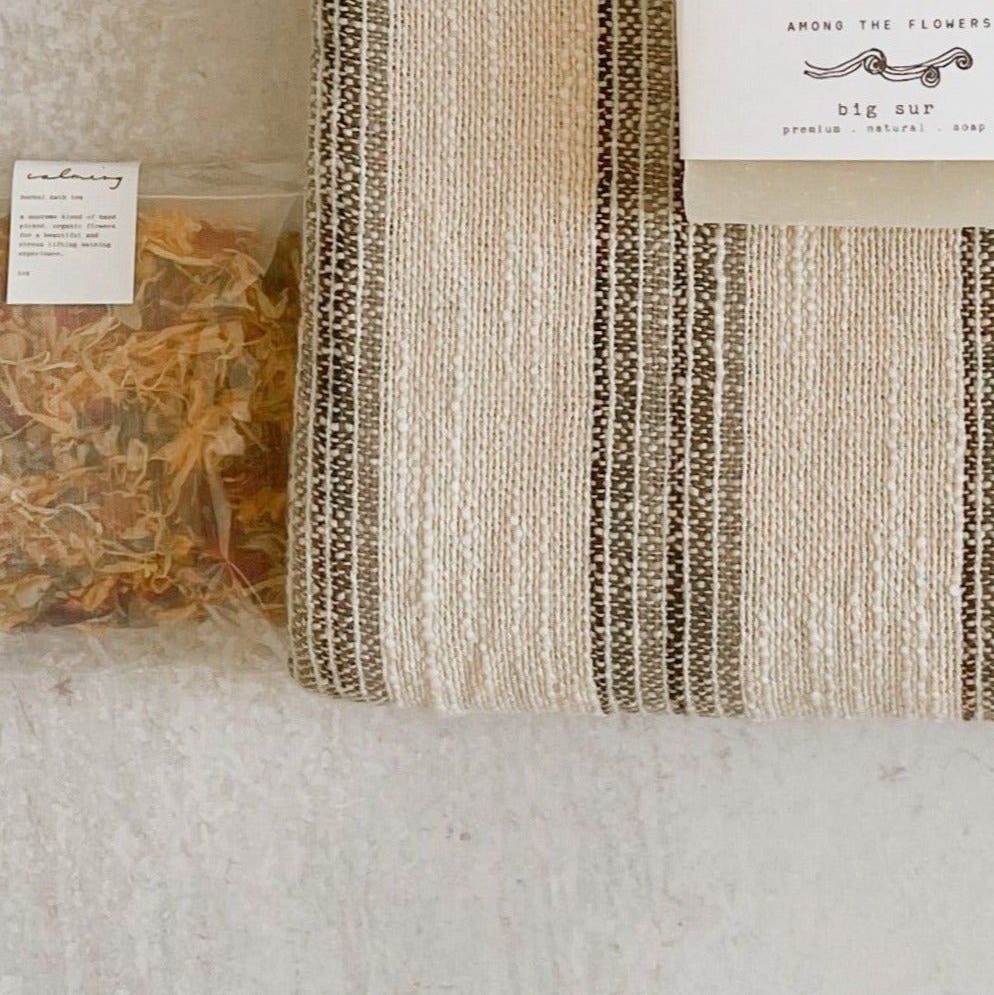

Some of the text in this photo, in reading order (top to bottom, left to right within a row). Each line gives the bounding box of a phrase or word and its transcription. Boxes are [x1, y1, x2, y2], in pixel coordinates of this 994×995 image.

[787, 18, 990, 31] AMONG THE FLOWERS
[838, 103, 934, 118] big sur
[783, 125, 840, 136] premium
[867, 124, 923, 133] natural
[953, 122, 986, 134] soap
[27, 167, 123, 190] calming
